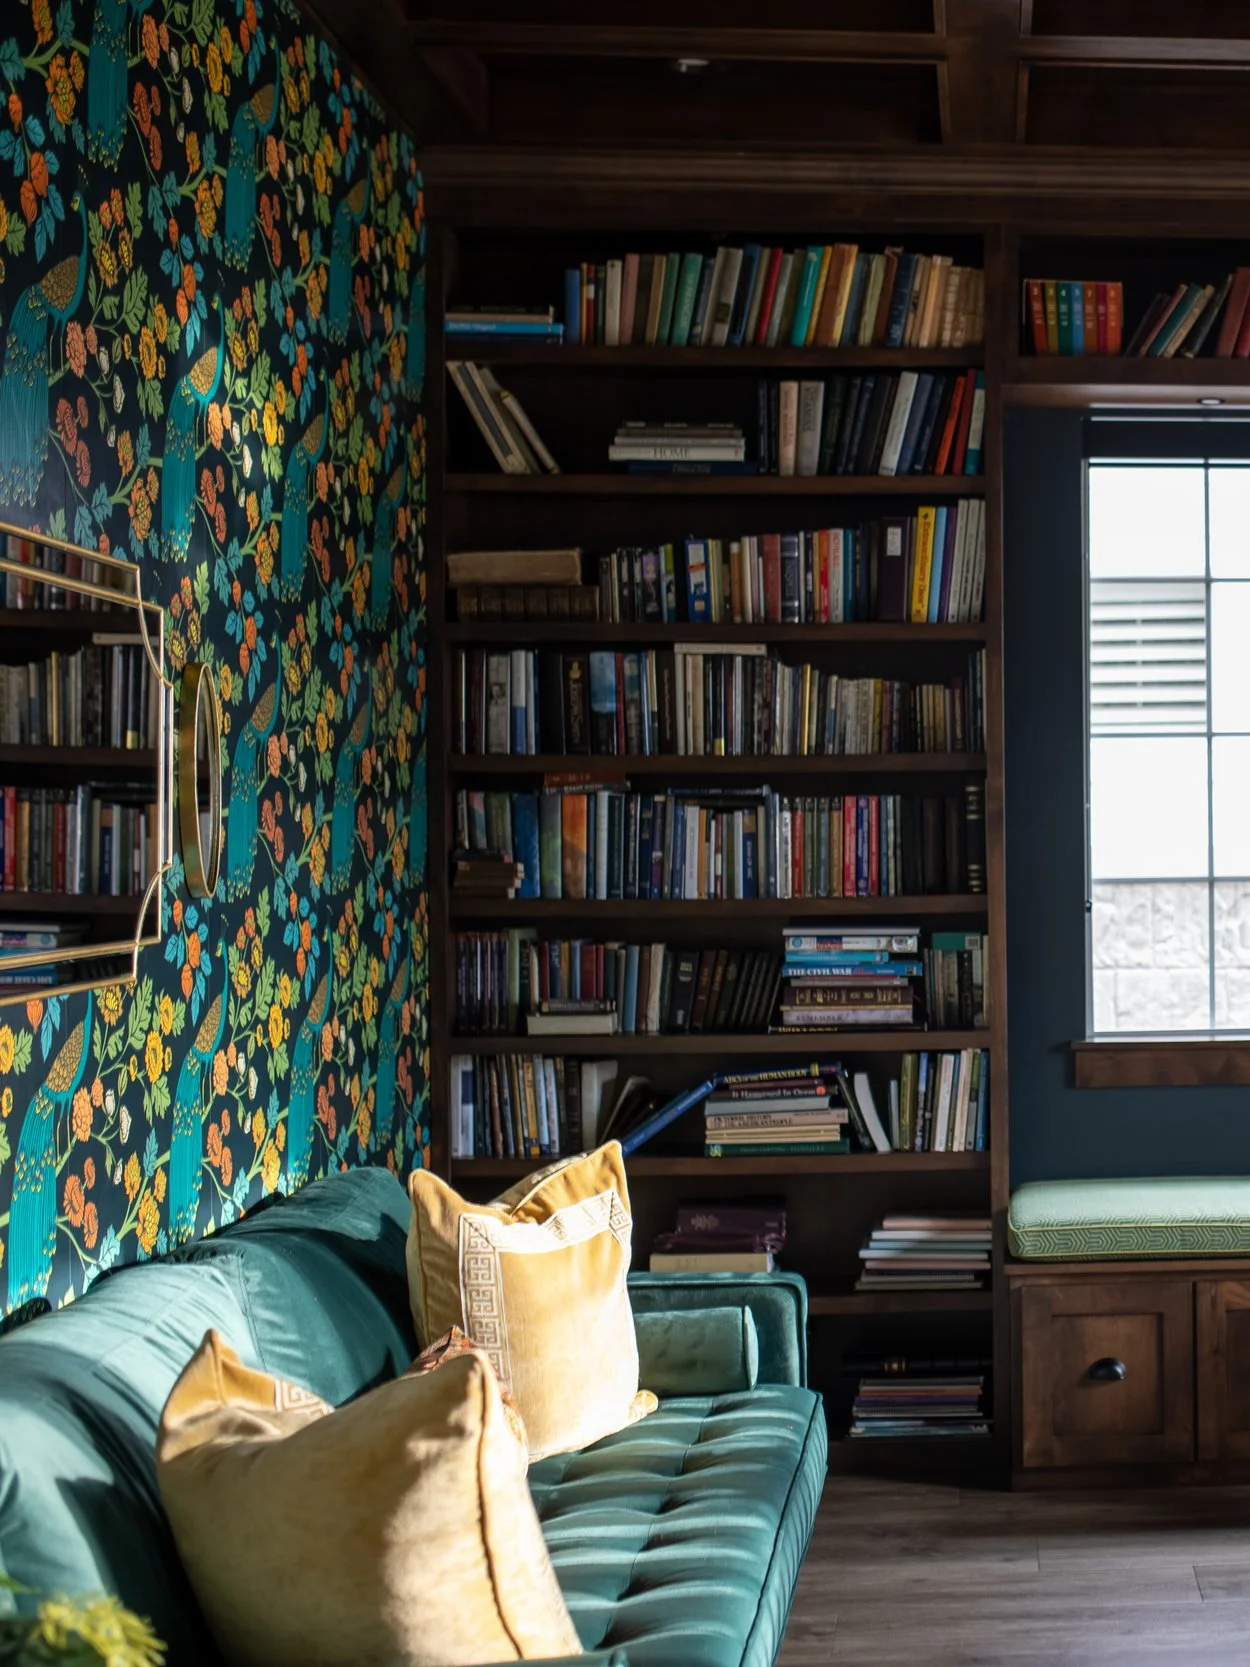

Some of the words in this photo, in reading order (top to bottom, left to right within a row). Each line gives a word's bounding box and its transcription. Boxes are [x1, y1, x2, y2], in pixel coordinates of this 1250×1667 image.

[653, 447, 692, 459] HOME
[787, 967, 806, 976] THE
[806, 967, 831, 976] CIVIL
[831, 967, 853, 976] WAR
